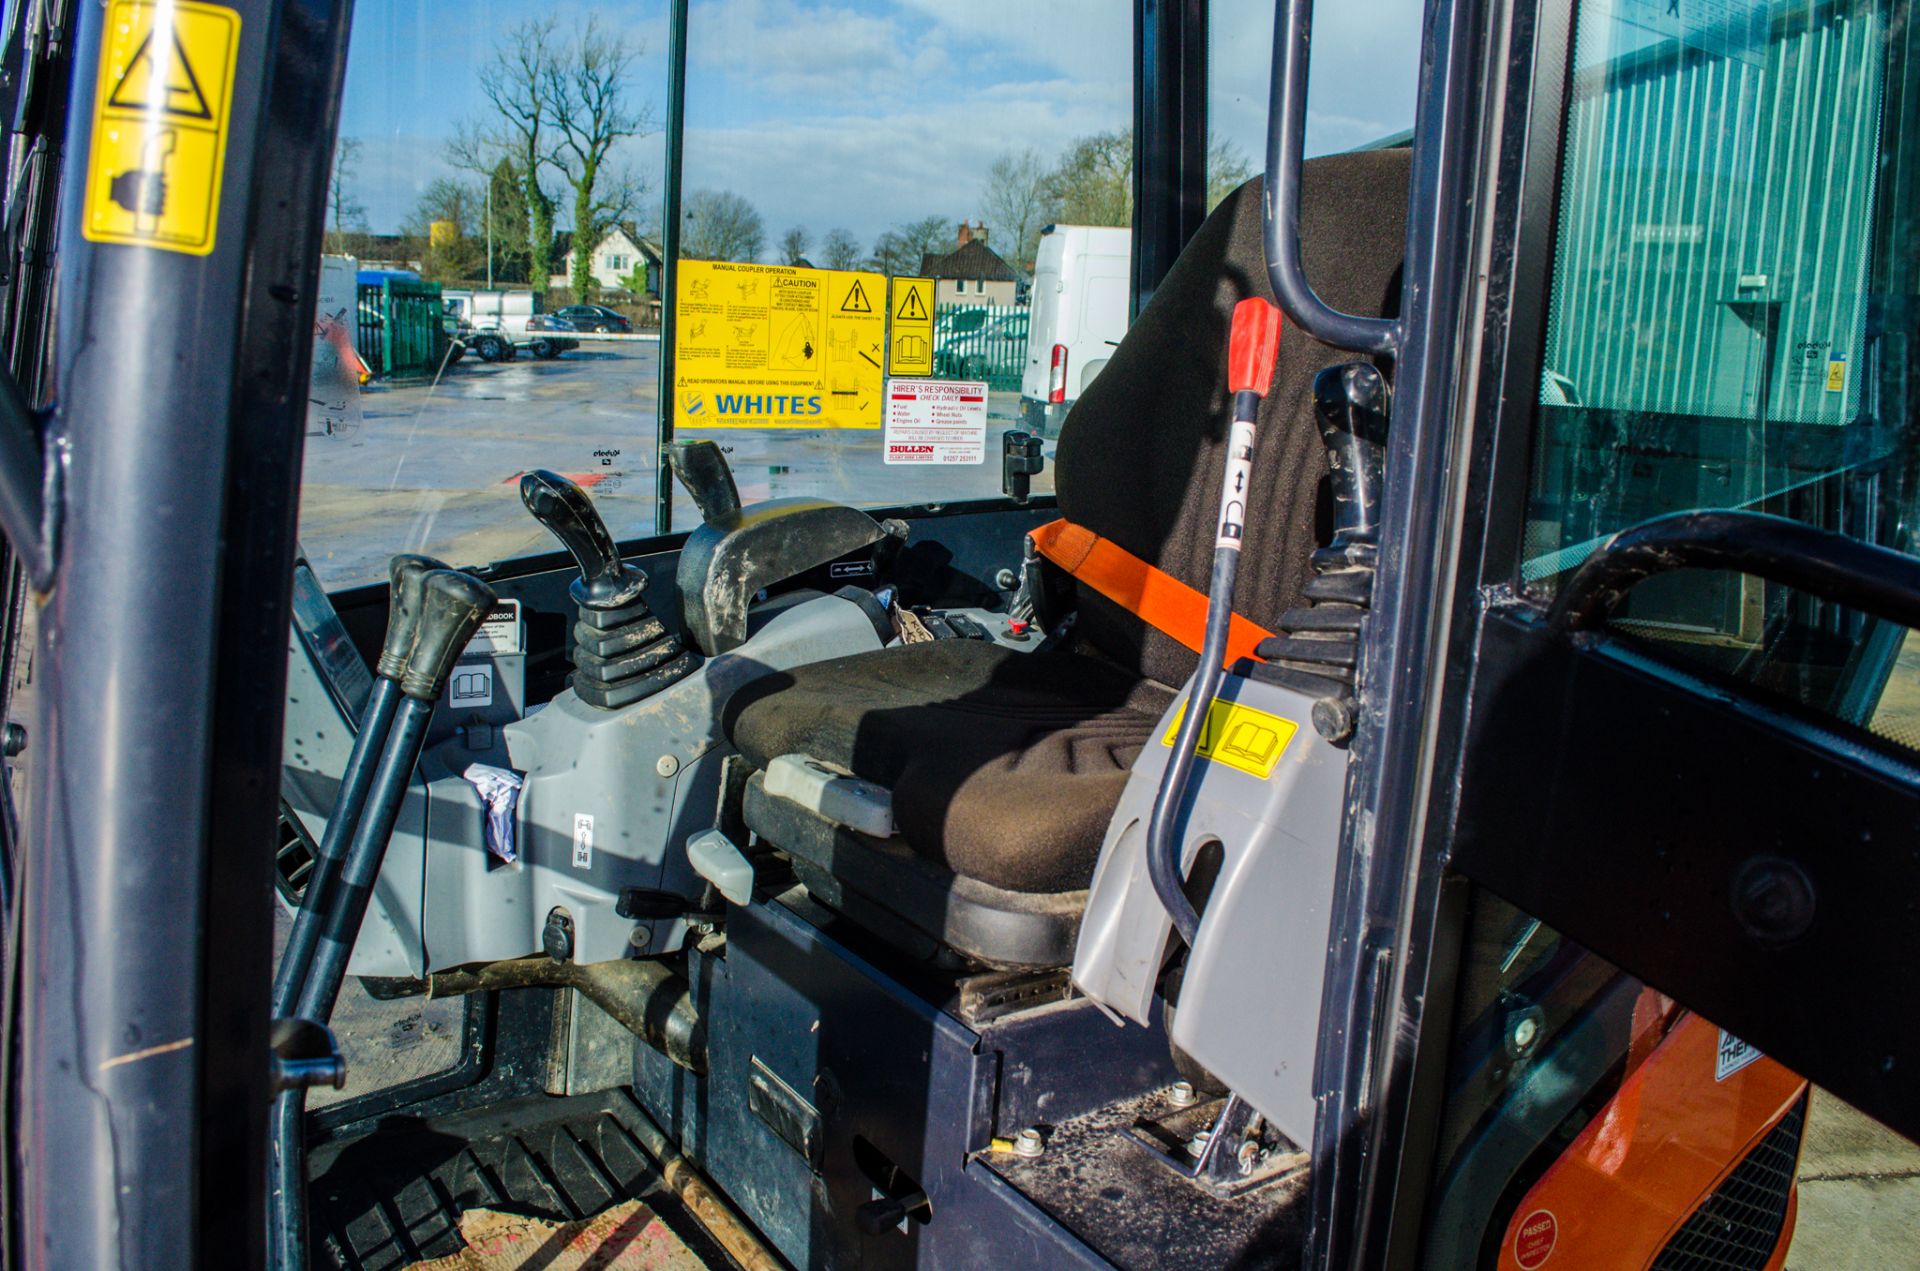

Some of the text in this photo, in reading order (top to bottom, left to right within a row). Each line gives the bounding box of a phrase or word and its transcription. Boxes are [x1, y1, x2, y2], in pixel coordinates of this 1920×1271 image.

[712, 263, 797, 276] MANUAL COUPLER OPERATION
[782, 278, 817, 288] CAUTION
[893, 384, 983, 395] HIRER'S RESPONSIBILITY
[715, 394, 822, 415] WHITES
[889, 445, 935, 453] BULLEN
